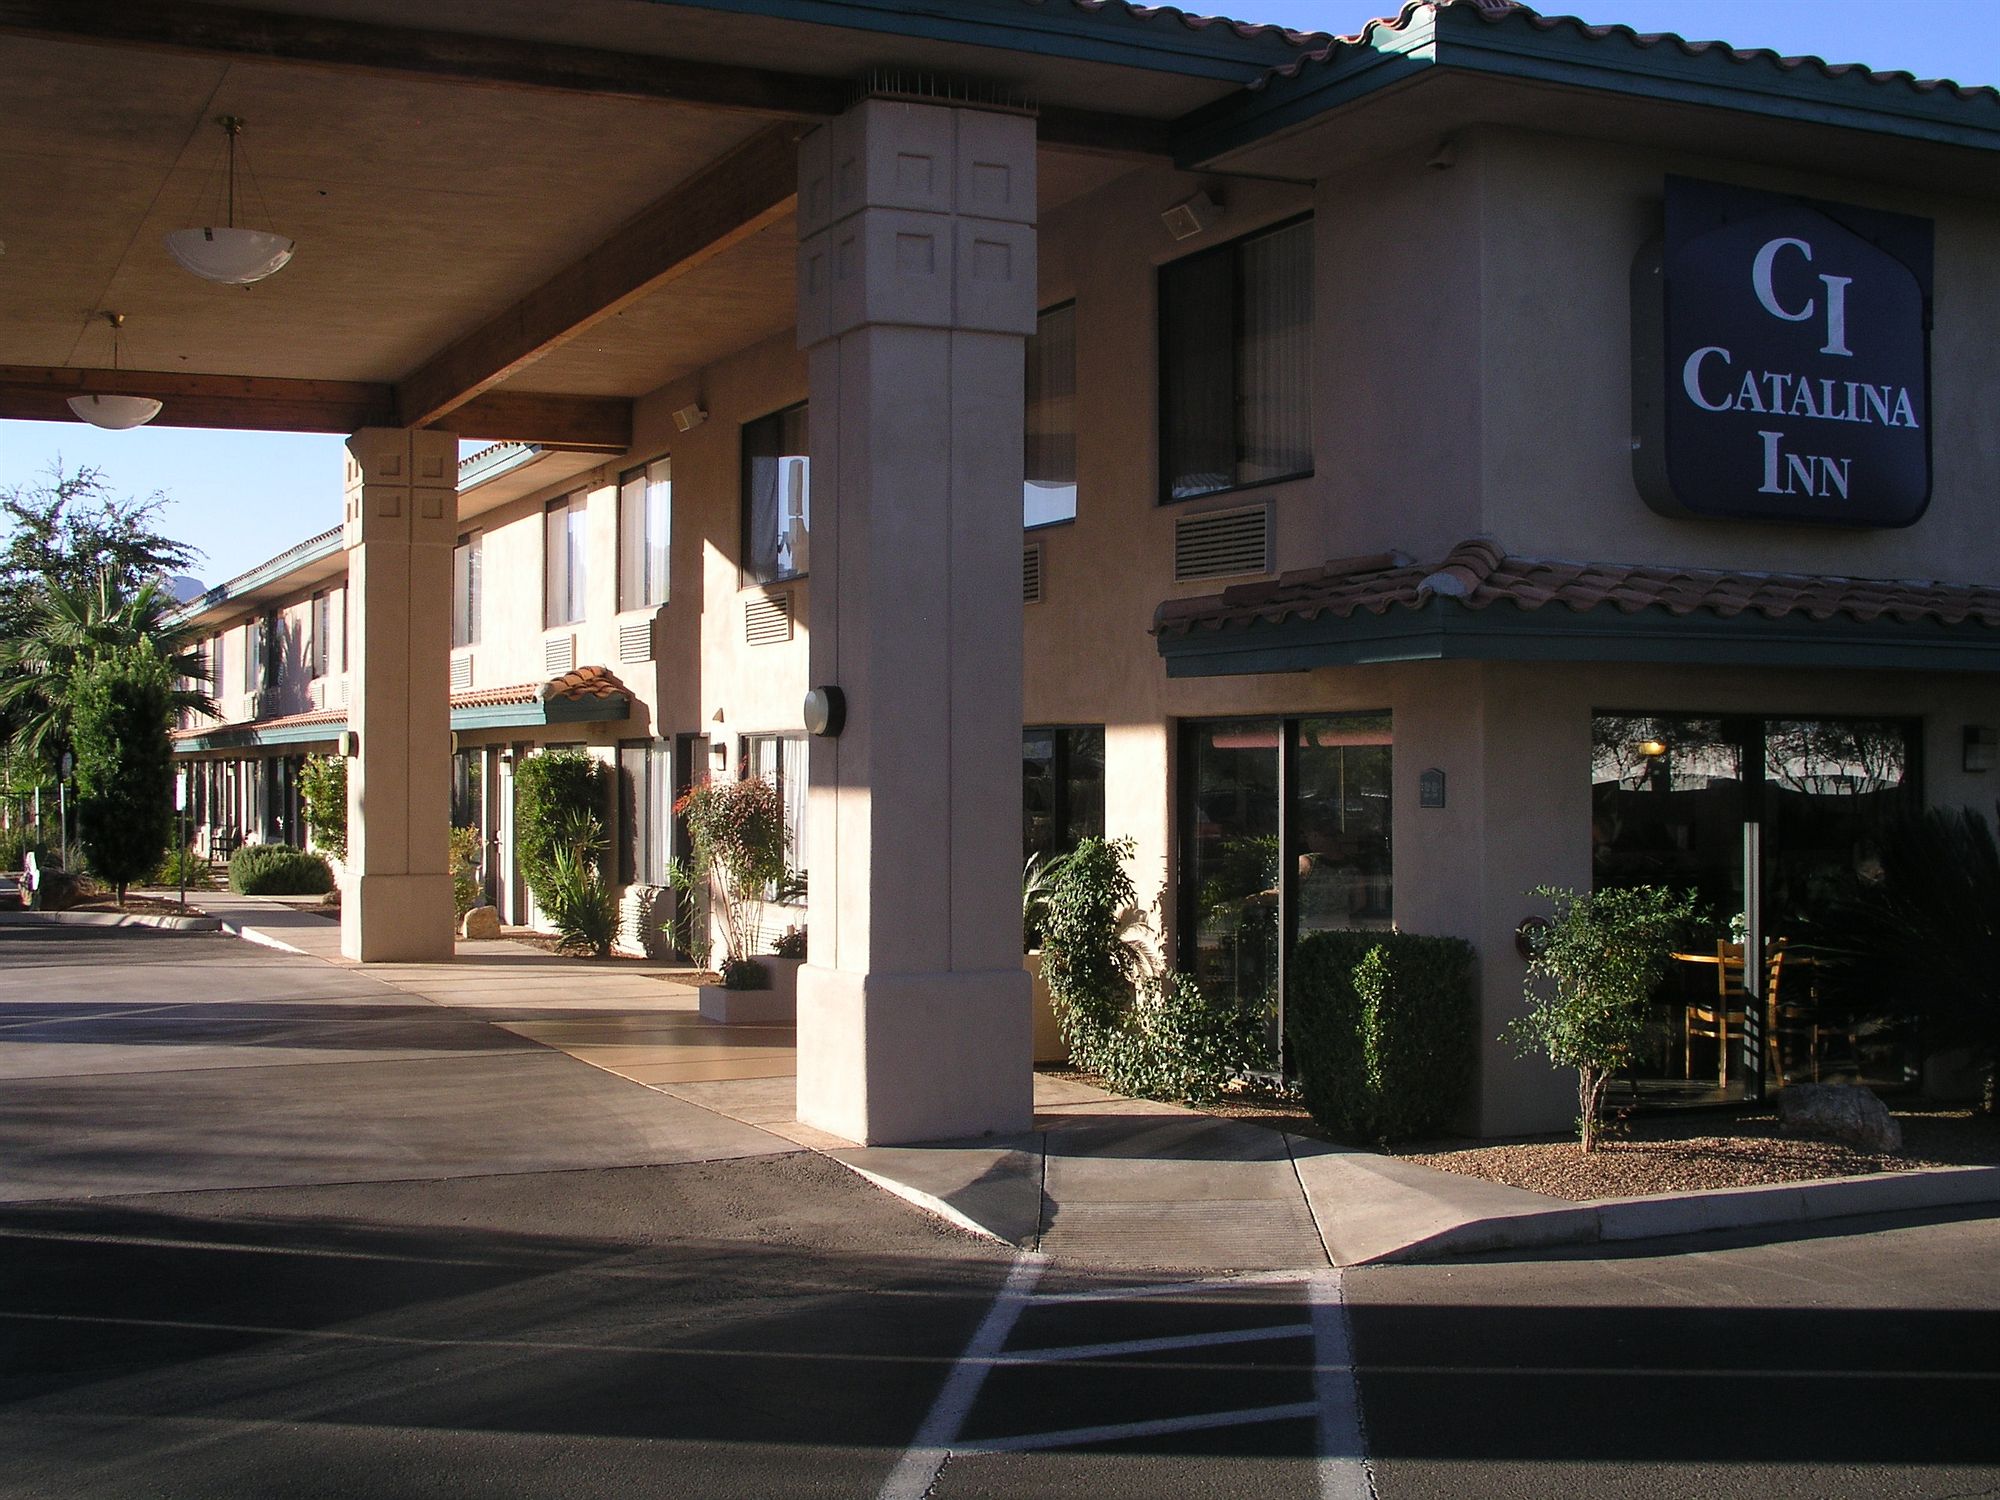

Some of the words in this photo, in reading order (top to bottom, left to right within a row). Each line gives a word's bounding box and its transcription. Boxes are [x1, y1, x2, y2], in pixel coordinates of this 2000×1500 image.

[1753, 237, 1852, 356] CI
[1683, 346, 1919, 428] CATALINA
[1758, 431, 1851, 499] INN
